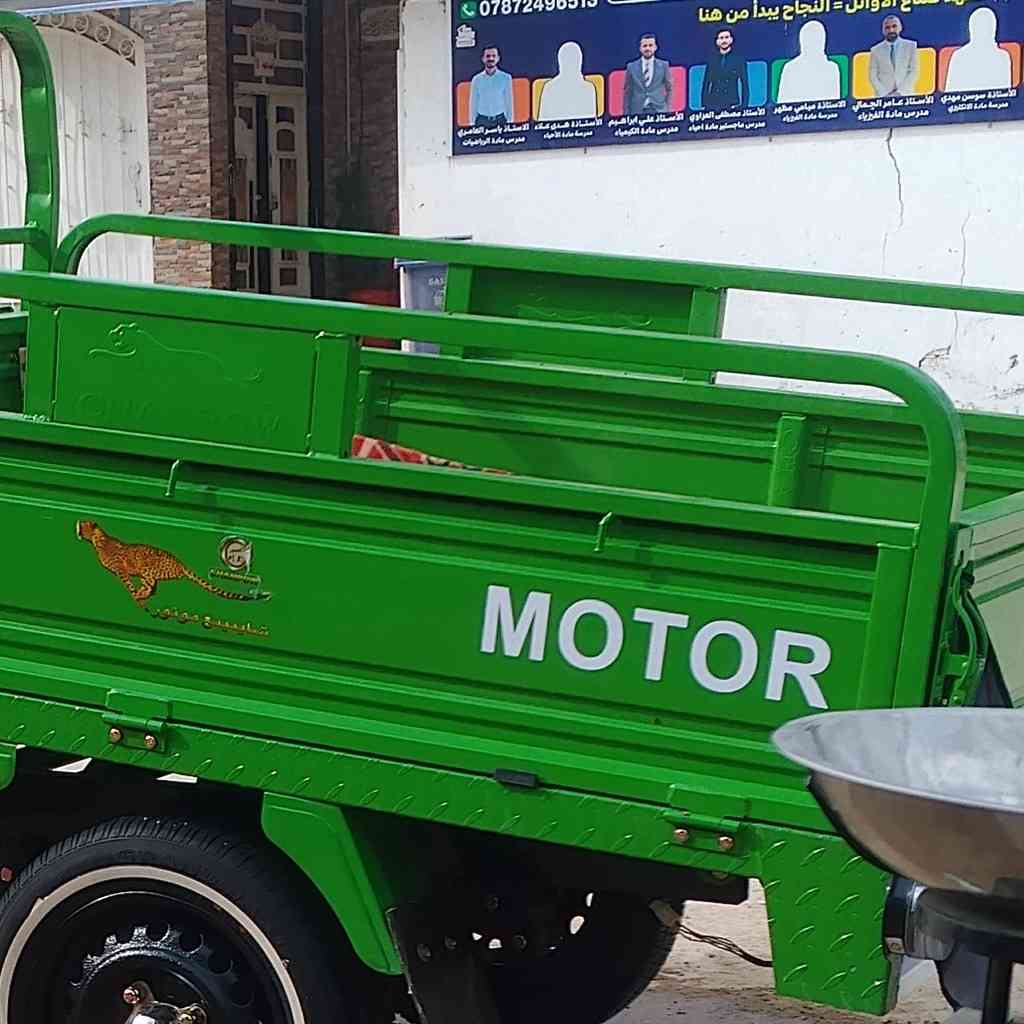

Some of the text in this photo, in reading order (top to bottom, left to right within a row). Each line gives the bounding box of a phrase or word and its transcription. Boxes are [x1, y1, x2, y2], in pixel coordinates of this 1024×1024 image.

[698, 6, 723, 22] هنا
[726, 8, 749, 23] من
[782, 0, 830, 19] النجاح
[480, 584, 832, 709] MOTOR
